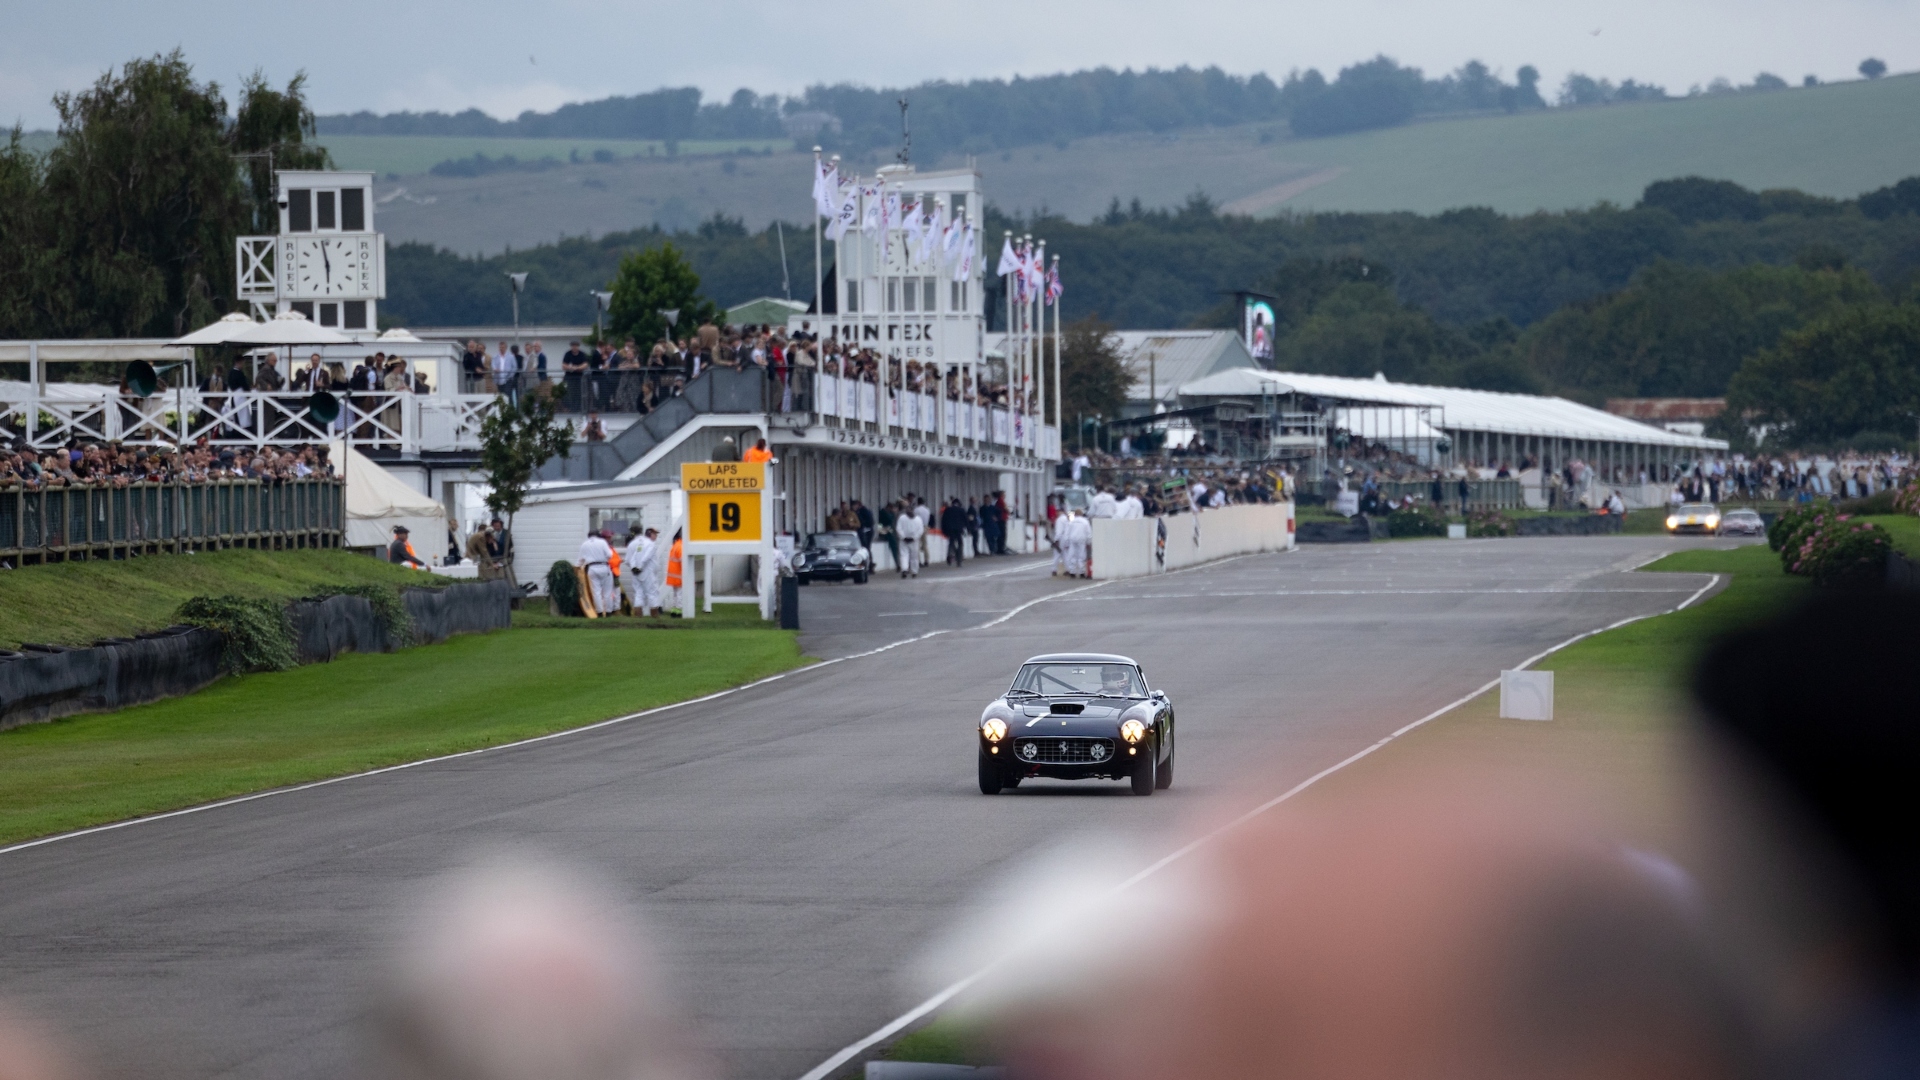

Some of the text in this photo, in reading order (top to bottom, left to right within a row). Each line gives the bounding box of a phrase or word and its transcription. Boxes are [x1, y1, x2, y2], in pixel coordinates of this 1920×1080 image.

[286, 243, 294, 291] ROLEX
[360, 242, 369, 291] ROLEX
[831, 324, 933, 340] MINTEX
[708, 465, 738, 475] LAPS
[689, 478, 758, 489] COMPLETED
[709, 502, 740, 532] 19
